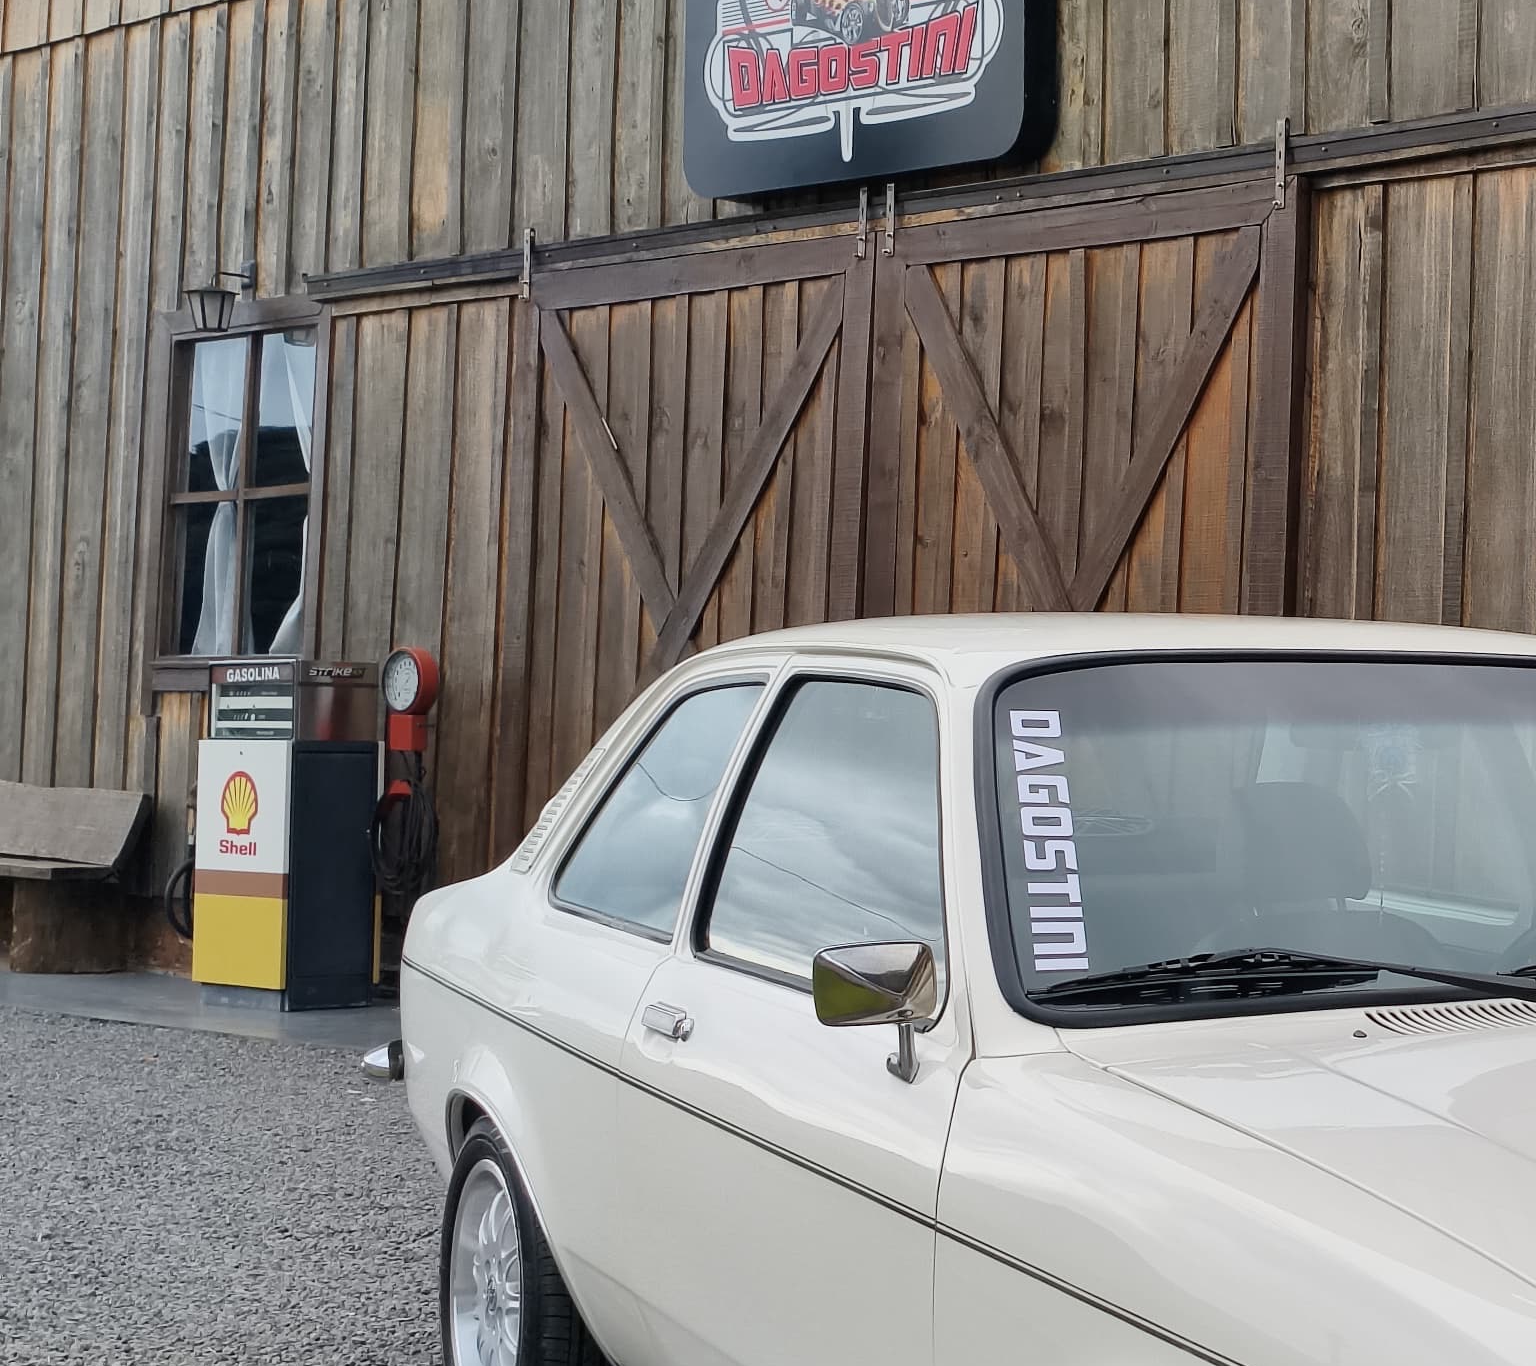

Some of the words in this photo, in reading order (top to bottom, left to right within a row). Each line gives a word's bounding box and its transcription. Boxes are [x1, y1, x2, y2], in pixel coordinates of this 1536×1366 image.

[727, 3, 979, 112] DAGOSTINI
[226, 666, 280, 683] GASOLINA
[219, 839, 257, 857] Shell
[1009, 709, 1089, 971] DAGOSTINI
